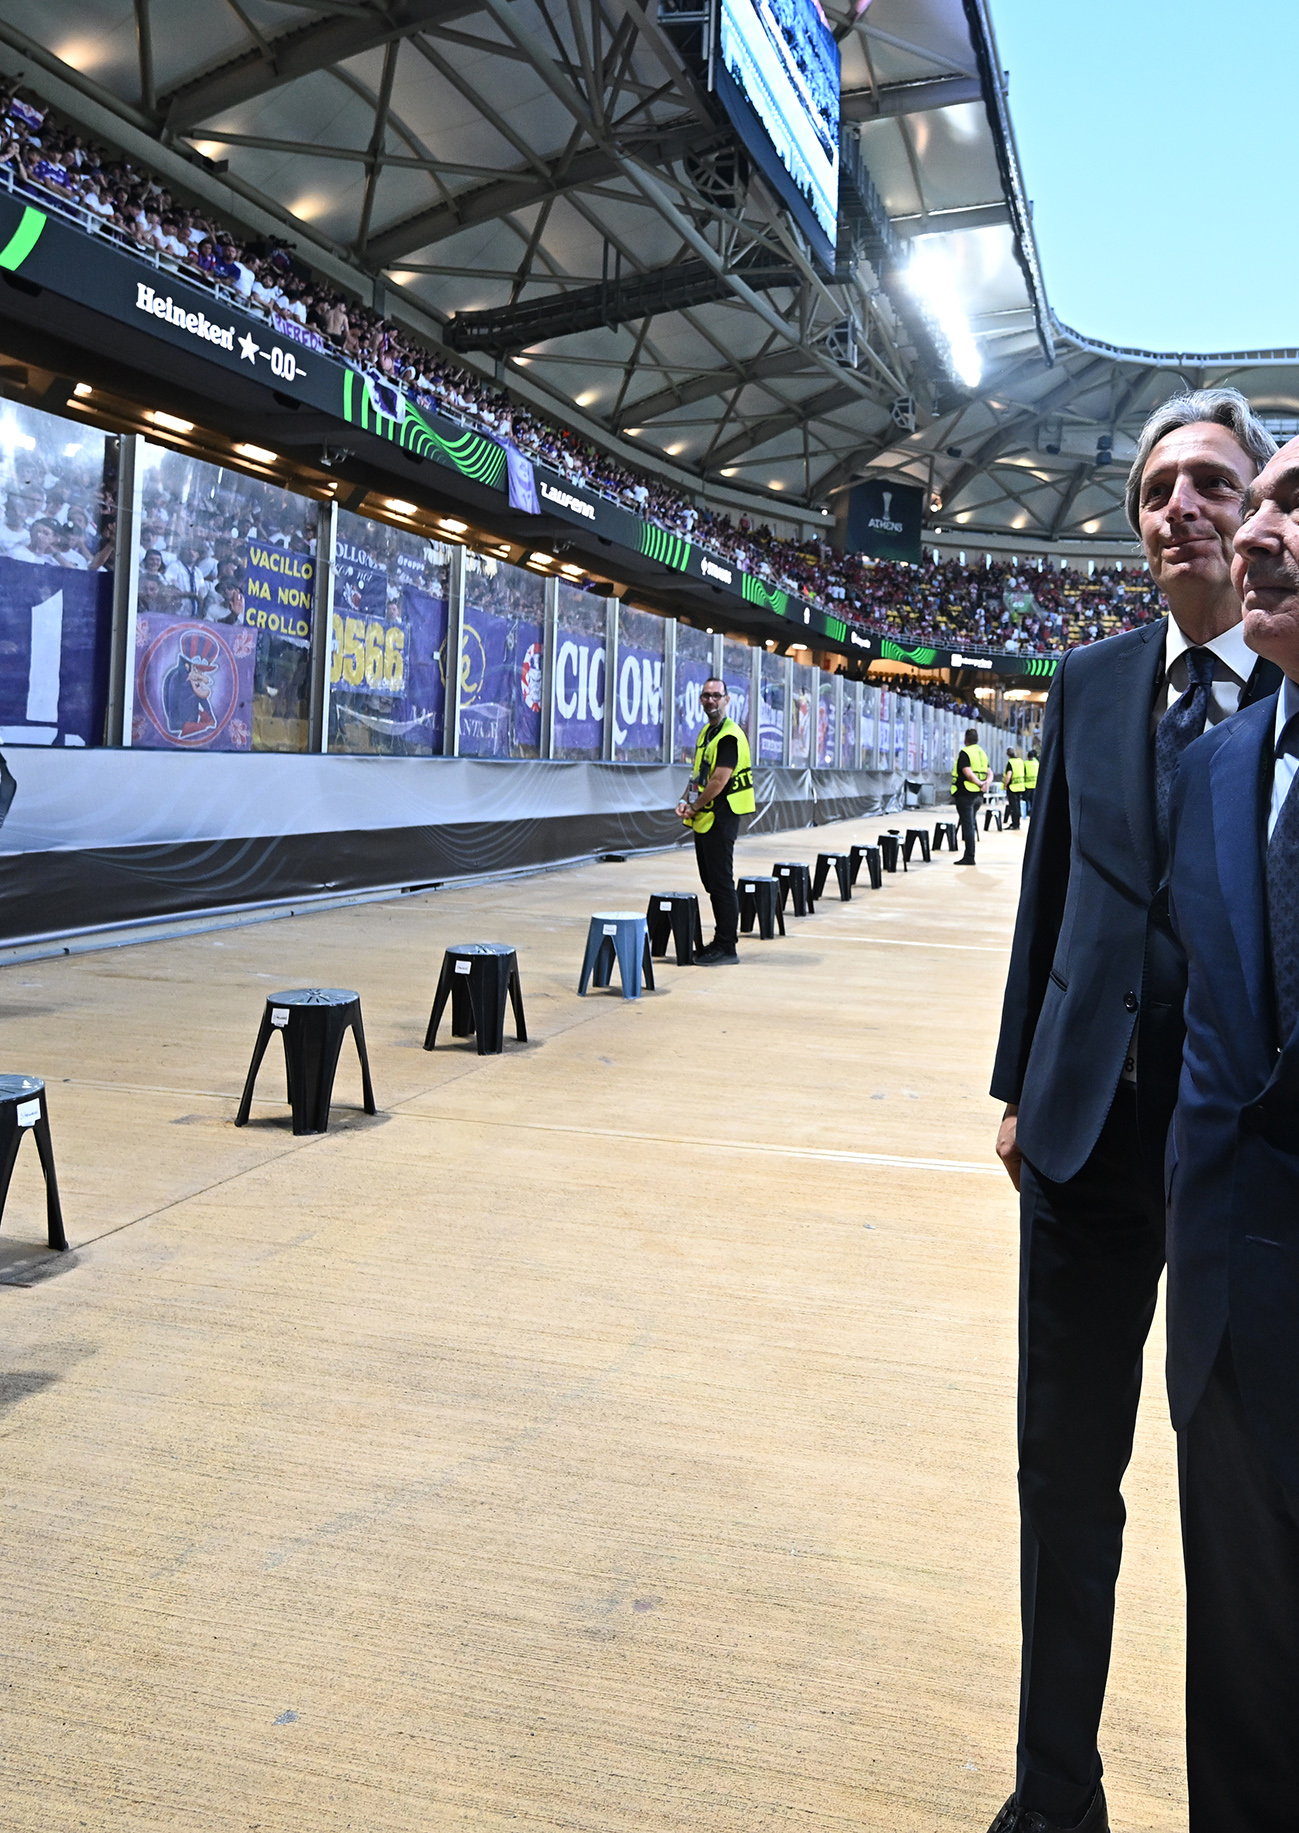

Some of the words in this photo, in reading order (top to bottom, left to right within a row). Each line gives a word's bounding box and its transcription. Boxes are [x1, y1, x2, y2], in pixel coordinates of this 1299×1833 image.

[136, 282, 235, 351] Heineken
[868, 518, 903, 533] ATHENS
[250, 546, 313, 579] VACILLO
[248, 577, 271, 600] MA
[278, 586, 311, 610] NON
[246, 607, 309, 637] CROLLO
